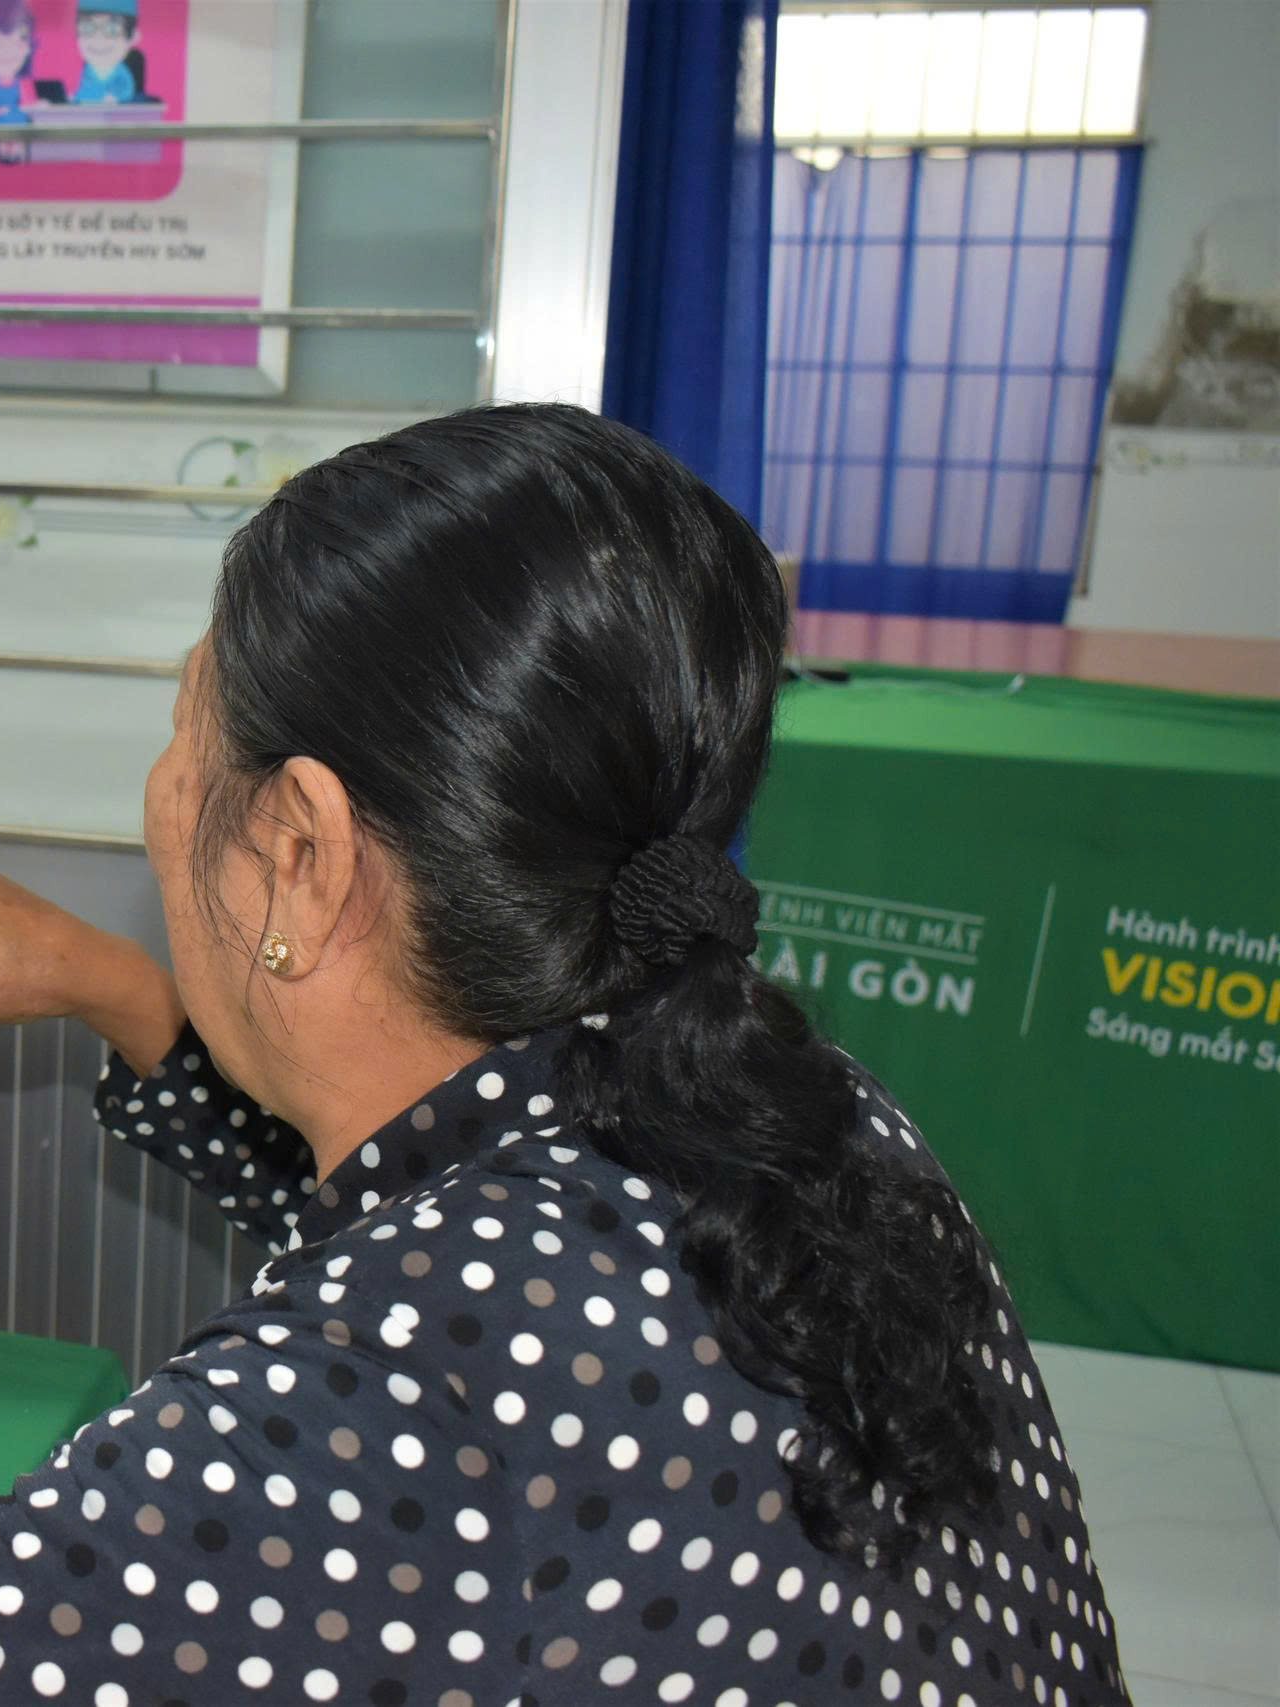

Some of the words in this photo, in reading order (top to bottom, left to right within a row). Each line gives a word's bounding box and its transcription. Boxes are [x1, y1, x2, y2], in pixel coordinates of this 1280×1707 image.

[1106, 905, 1199, 951] Hành
[847, 957, 976, 1017] GÒN
[1086, 1006, 1173, 1058] Sáng
